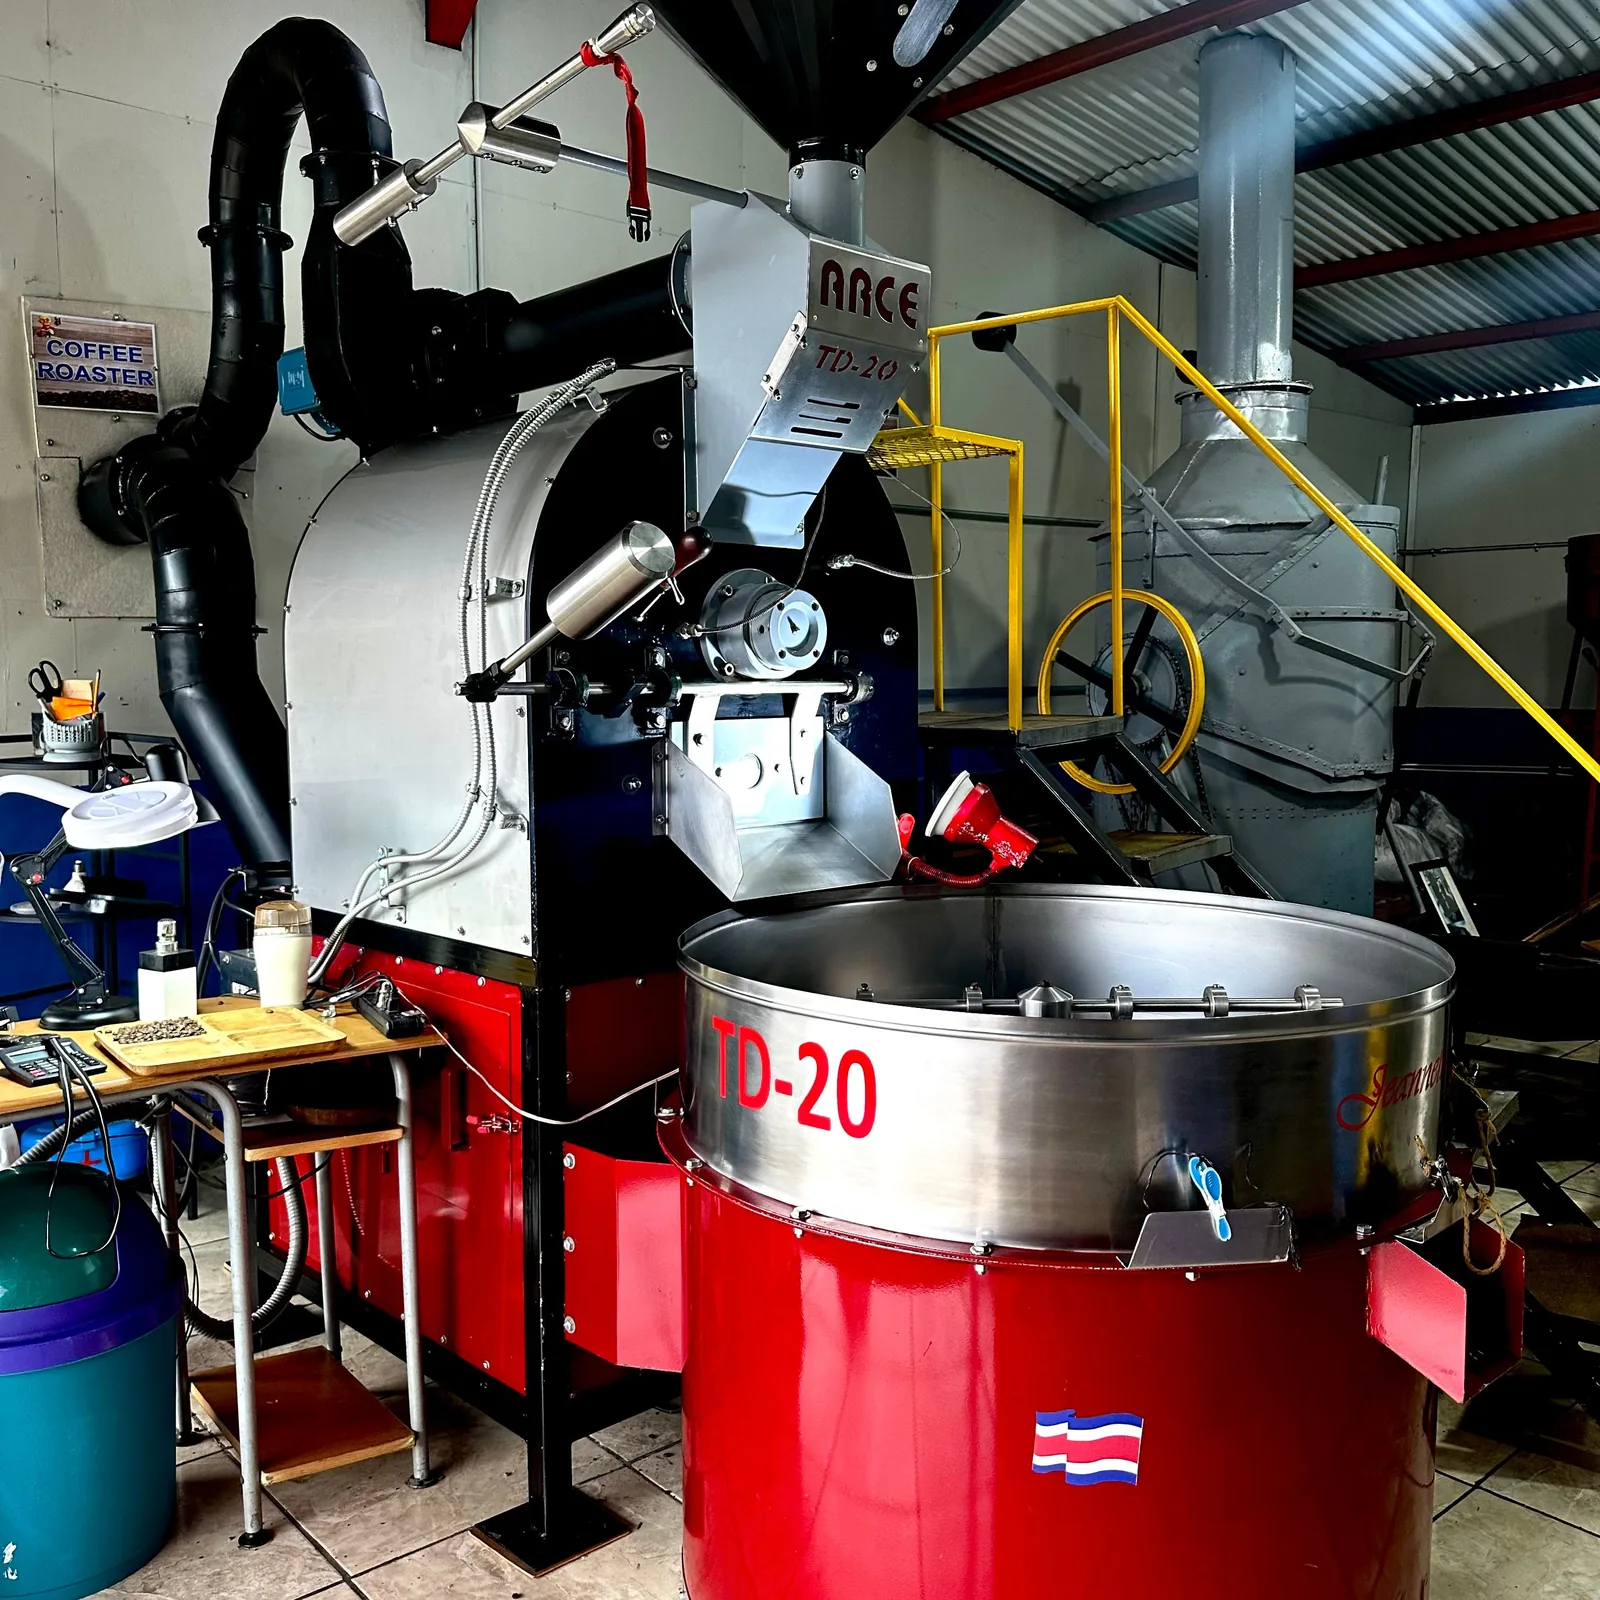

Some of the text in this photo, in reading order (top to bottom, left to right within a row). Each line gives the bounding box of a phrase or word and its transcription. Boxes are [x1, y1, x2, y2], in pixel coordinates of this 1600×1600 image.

[820, 259, 919, 330] ARCE
[47, 339, 143, 363] COFFEE
[815, 344, 898, 381] TD-20
[37, 361, 155, 386] ROASTER
[712, 1014, 877, 1139] TD-20
